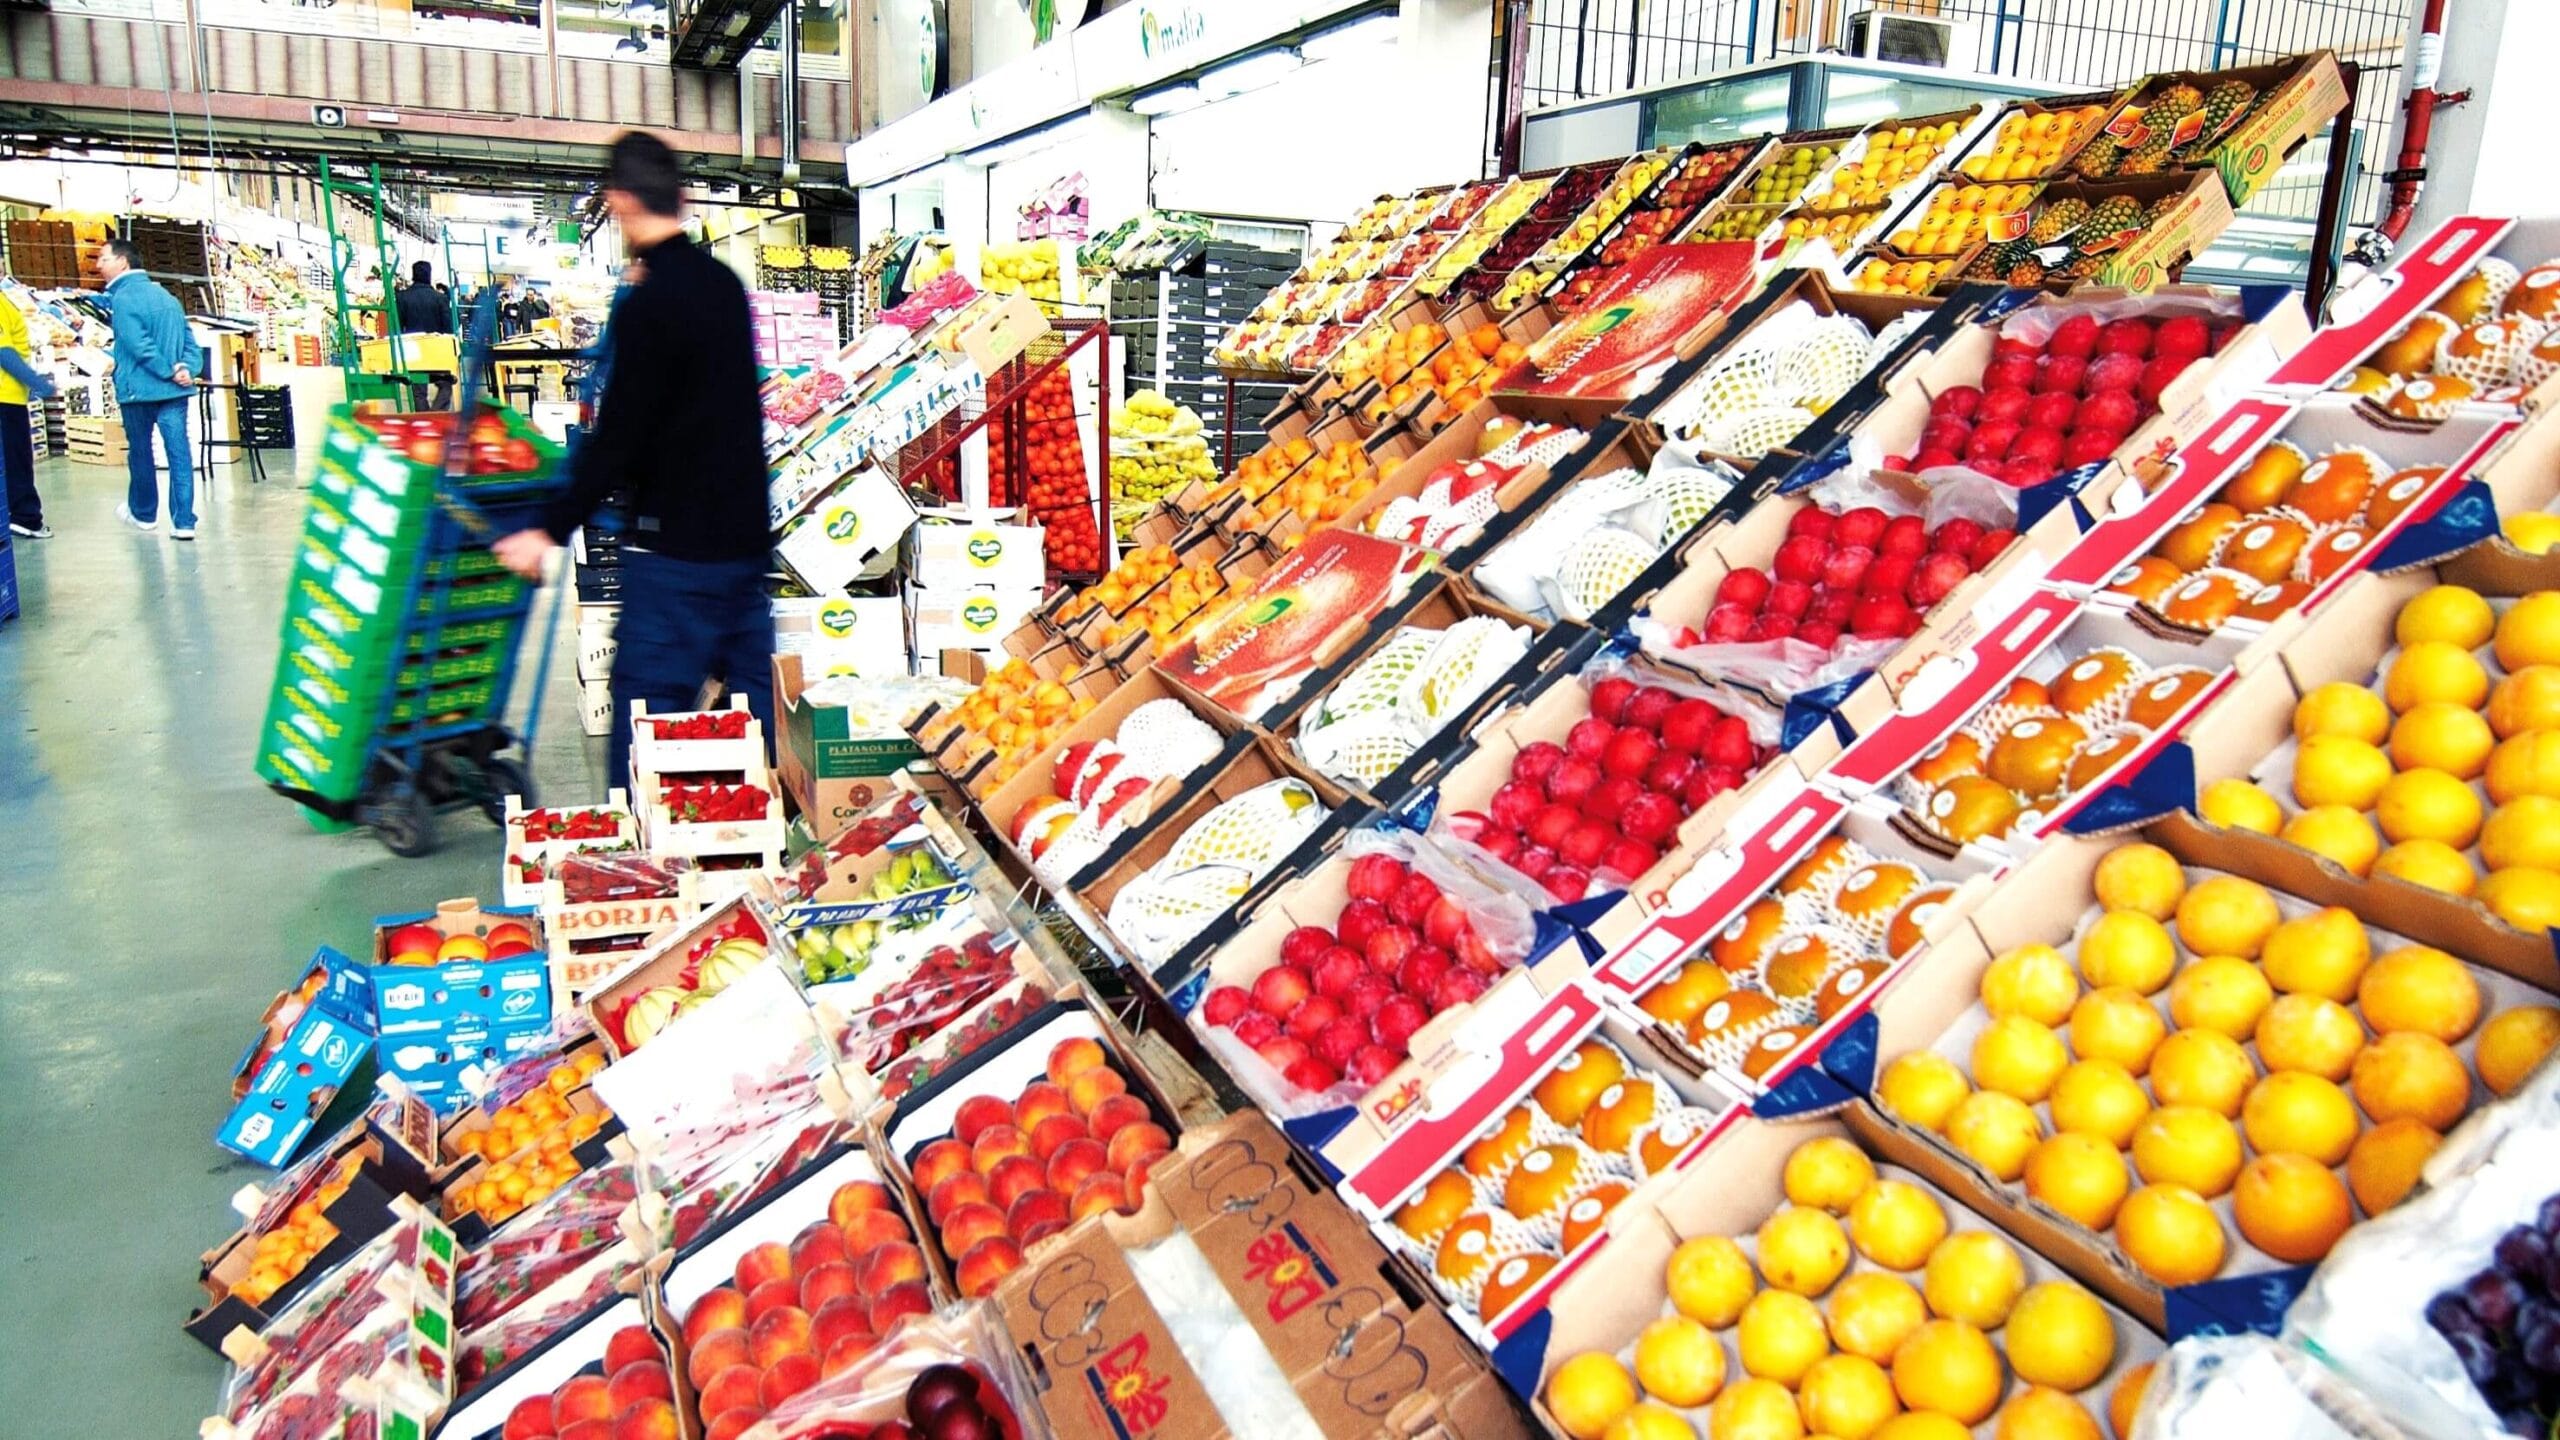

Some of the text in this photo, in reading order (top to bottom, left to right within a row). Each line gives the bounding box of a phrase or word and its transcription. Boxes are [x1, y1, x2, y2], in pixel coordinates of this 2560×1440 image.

[2288, 84, 2310, 105] GOLD
[560, 904, 679, 929] BORJA
[1374, 1078, 1422, 1121] Dole
[1242, 1230, 1325, 1324] Dole
[1097, 1331, 1173, 1433] Dole
